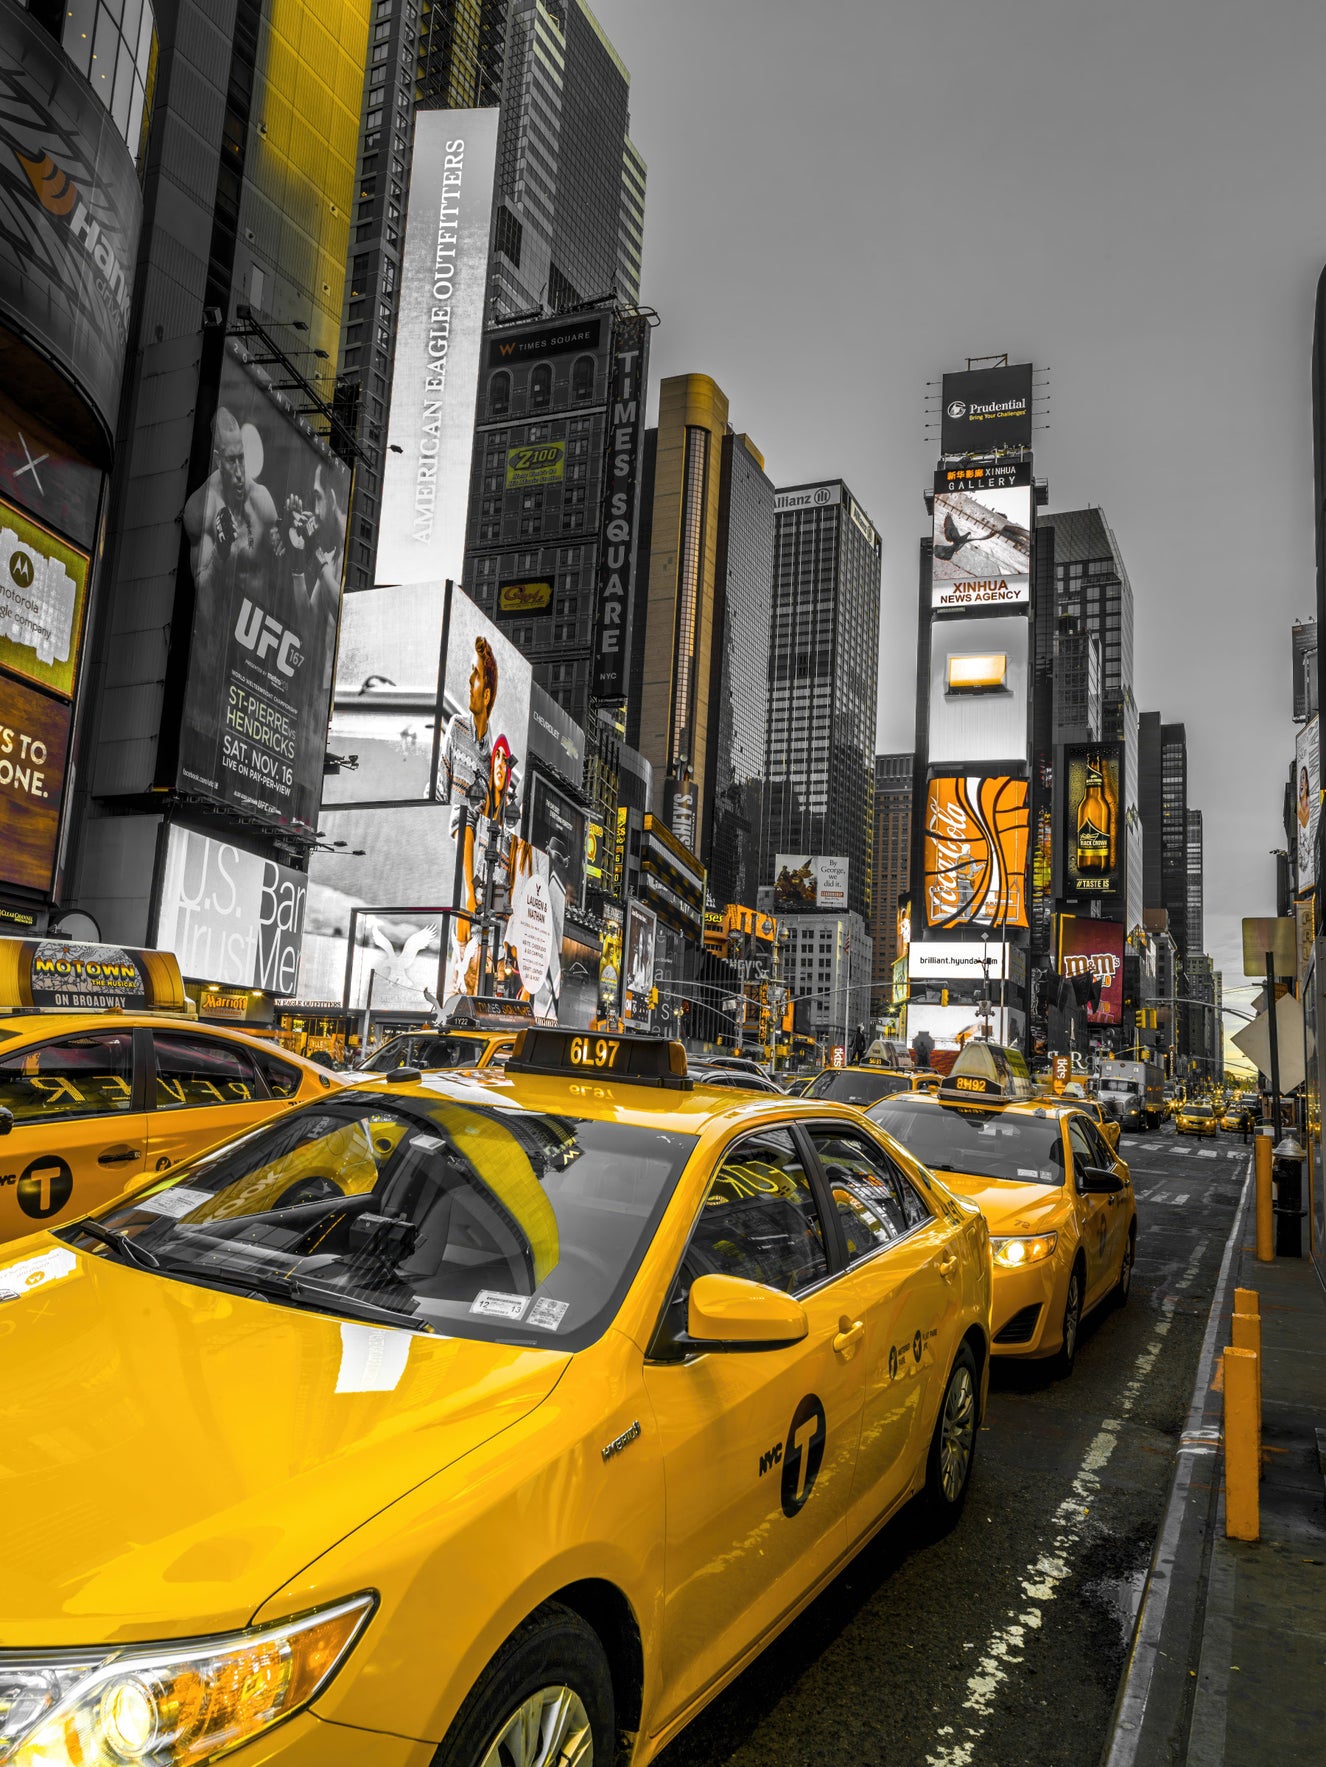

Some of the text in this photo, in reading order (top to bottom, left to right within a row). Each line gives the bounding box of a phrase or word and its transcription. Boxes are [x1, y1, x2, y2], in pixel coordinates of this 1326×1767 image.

[417, 138, 464, 544] AMERICAN EAGLE OUTFITTERS
[499, 331, 591, 356] W TIMES SQUARE
[969, 398, 1026, 414] Prudential
[968, 413, 983, 422] Bring
[983, 412, 997, 421] Your
[515, 448, 558, 470] Z100
[985, 466, 1016, 477] XINHUA
[948, 476, 1016, 490] GALLERY
[602, 350, 640, 654] TIMES SQUARE
[940, 590, 1021, 604] NEWS AGENCY
[953, 579, 1008, 595] XINHUA
[14, 613, 51, 641] company
[234, 597, 301, 678] UFC
[289, 648, 305, 668] 167
[599, 671, 618, 681] NYC
[228, 686, 289, 735] ST-PIERRE
[226, 706, 295, 760] HENDRICKS
[533, 711, 560, 740] CHEVROLET
[20, 733, 47, 765] TO
[222, 735, 294, 786] SAT. NOV. 16
[222, 757, 238, 770] LIVE
[238, 765, 249, 777] ON
[821, 866, 846, 876] George,
[829, 860, 838, 868] By
[1076, 880, 1110, 889] #TASTE IS
[527, 894, 544, 910] LAUREN
[527, 908, 545, 924] NATHAN
[33, 956, 138, 979] MOTOWN
[91, 979, 137, 989] THE MUSICAL
[55, 993, 127, 1008] ON BROADWAY
[570, 1037, 621, 1067] 6L97
[833, 1047, 845, 1067] tkts
[1056, 1057, 1069, 1080] tkts
[956, 1077, 986, 1092] 8H92
[1014, 1218, 1031, 1229] 72
[480, 1300, 490, 1309] 12
[511, 1305, 522, 1314] 13
[759, 1442, 783, 1477] NYC
